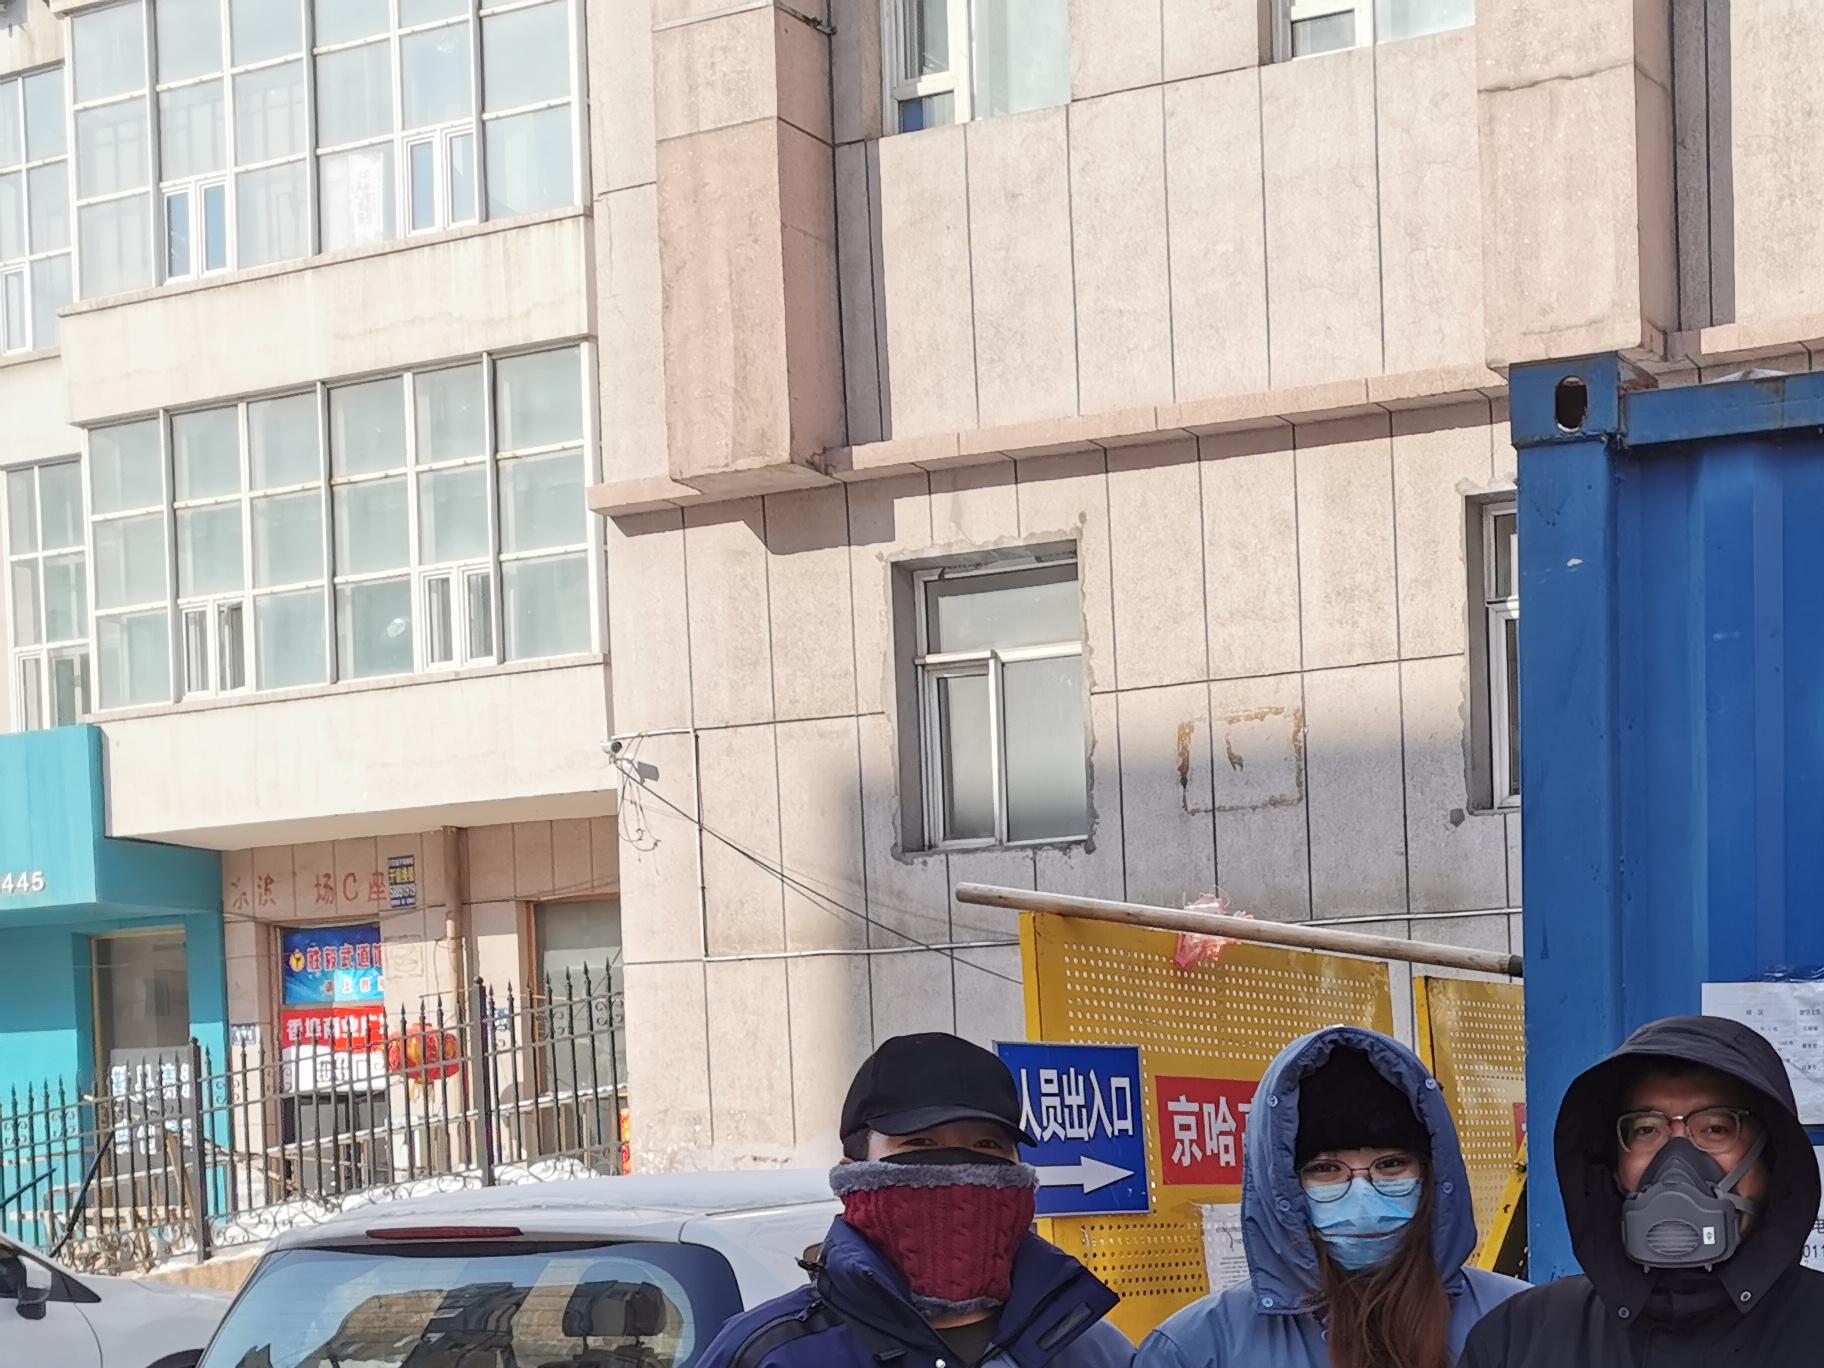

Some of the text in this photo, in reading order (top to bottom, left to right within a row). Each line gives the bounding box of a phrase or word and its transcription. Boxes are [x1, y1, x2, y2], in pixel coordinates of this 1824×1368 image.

[1019, 1067, 1134, 1142] 人员出入口
